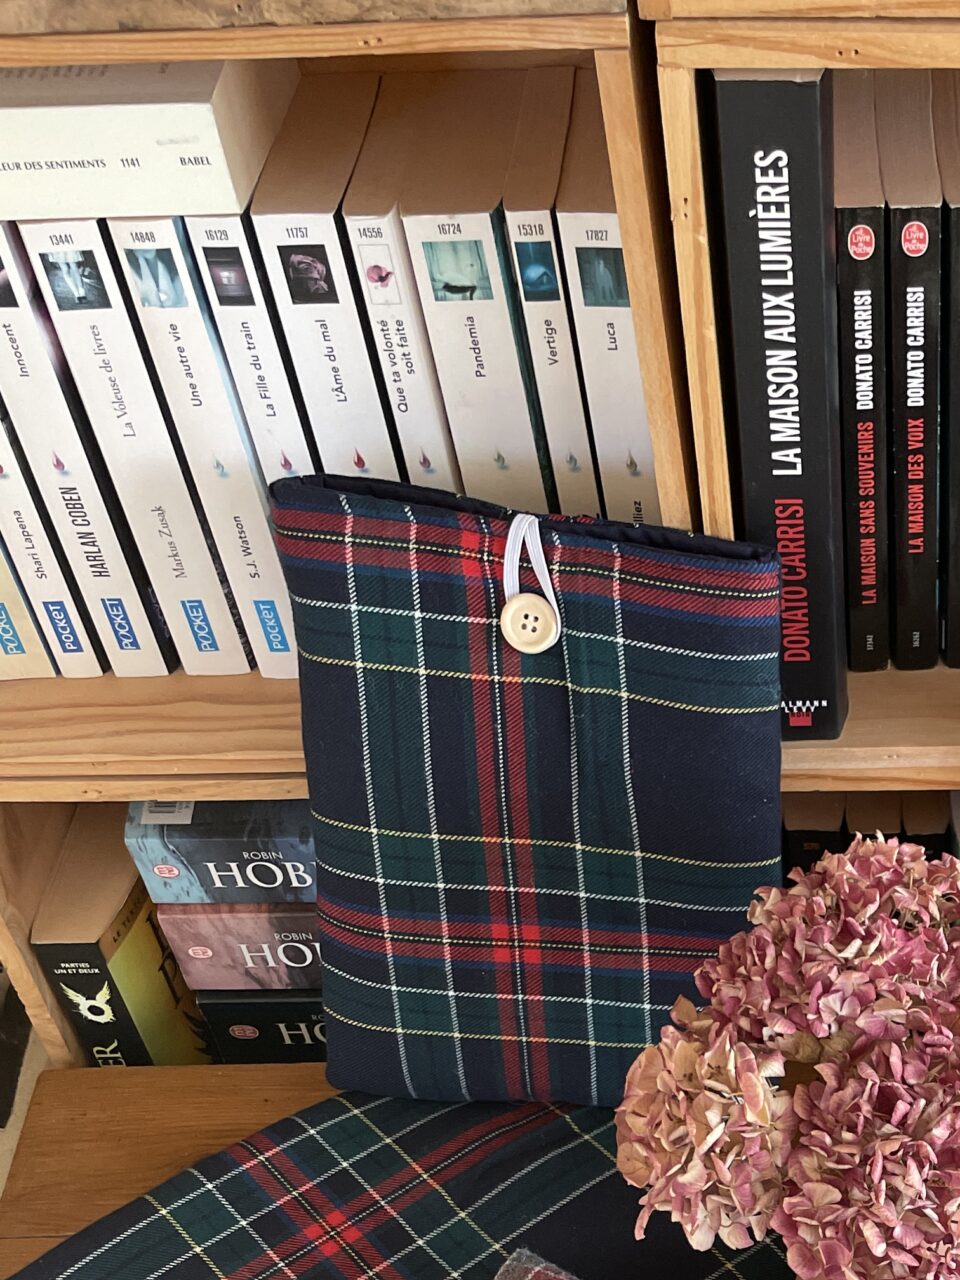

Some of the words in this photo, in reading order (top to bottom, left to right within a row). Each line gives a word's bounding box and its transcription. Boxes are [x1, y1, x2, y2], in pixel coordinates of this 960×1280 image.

[24, 161, 43, 170] DES
[45, 159, 106, 170] SENTIMENTS
[121, 157, 141, 168] 1141
[180, 156, 212, 166] BABEL
[437, 223, 462, 235] 16724
[517, 224, 545, 236] 15318
[749, 150, 794, 286] LUMIÈRES
[49, 234, 74, 246] 13441
[204, 229, 229, 241] 16129
[286, 227, 309, 239] 11757
[358, 227, 383, 239] 14556
[585, 230, 608, 241] 17827
[315, 319, 331, 341] mal
[762, 291, 796, 343] AUX
[854, 290, 872, 349] CARRISI
[906, 287, 924, 346] CARRISI
[90, 324, 107, 356] livres
[168, 323, 181, 342] vie
[240, 321, 257, 351] train
[377, 319, 397, 368] volonté
[395, 319, 410, 349] faite
[464, 316, 487, 378] Pandemia
[544, 319, 559, 366] Vertige
[607, 322, 618, 351] Luca
[2, 323, 30, 377] Innocent
[177, 346, 194, 379] autre
[250, 354, 262, 370] du
[324, 347, 336, 363] du
[400, 351, 415, 374] soit
[104, 359, 113, 373] de
[392, 371, 401, 384] ta
[907, 350, 924, 407] DONATO
[189, 383, 203, 407] Une
[255, 375, 270, 401] Fille
[765, 350, 801, 442] MAISON
[855, 354, 873, 410] DONATO
[110, 376, 129, 419] Voleuse
[266, 404, 276, 417] La
[397, 387, 408, 413] Que
[124, 422, 136, 438] La
[908, 418, 924, 451] VOIX
[772, 447, 802, 475] LA
[857, 422, 875, 496] SOUVENIRS
[908, 454, 924, 480] DES
[58, 487, 91, 526] COBEN
[859, 500, 875, 534] SANS
[908, 484, 924, 536] MAISON
[13, 510, 35, 551] Lapena
[151, 505, 173, 539] Zusak
[233, 516, 252, 558] Watson
[774, 498, 808, 581] CARRISI
[908, 539, 924, 554] LA
[34, 554, 47, 579] Shari
[81, 532, 111, 578] HARLAN
[166, 540, 188, 579] Markus
[860, 537, 876, 589] MAISON
[249, 561, 260, 579] S.J.
[862, 591, 877, 605] LA
[106, 599, 138, 650] POCKET
[188, 601, 214, 650] POCKET
[781, 584, 811, 662] DONATO
[242, 851, 283, 860] ROBIN
[203, 861, 316, 888] HOB
[274, 933, 313, 941] ROBIN
[237, 942, 321, 968] HO
